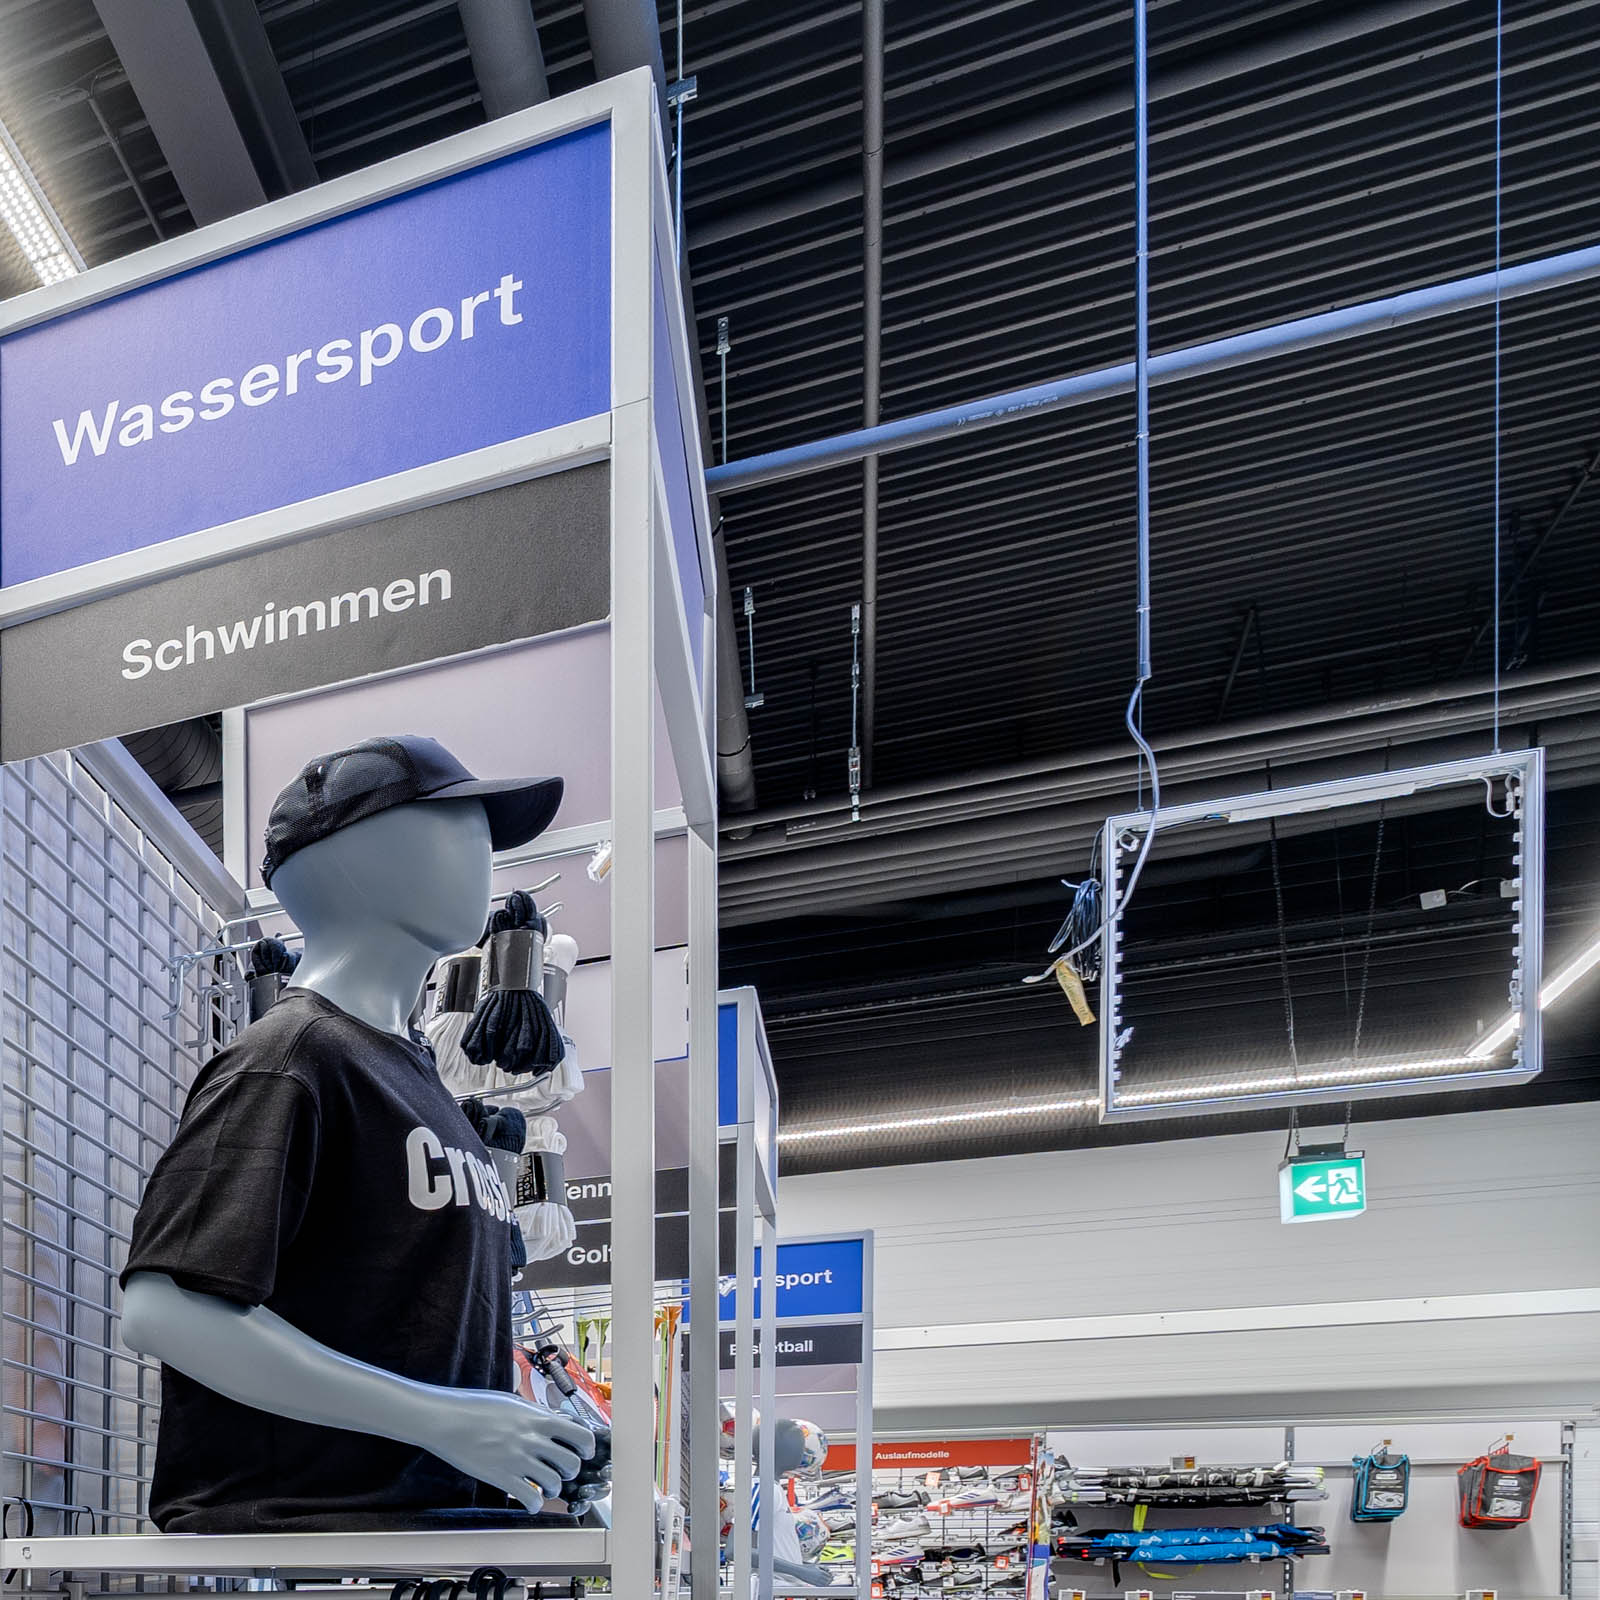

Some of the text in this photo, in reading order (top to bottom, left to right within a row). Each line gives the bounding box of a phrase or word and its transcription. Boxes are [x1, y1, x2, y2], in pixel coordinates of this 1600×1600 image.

[52, 272, 525, 467] Wassersport
[120, 566, 453, 681] Schwimmen
[563, 1181, 612, 1201] Tenn
[875, 1451, 950, 1461] Auslaufmodelle
